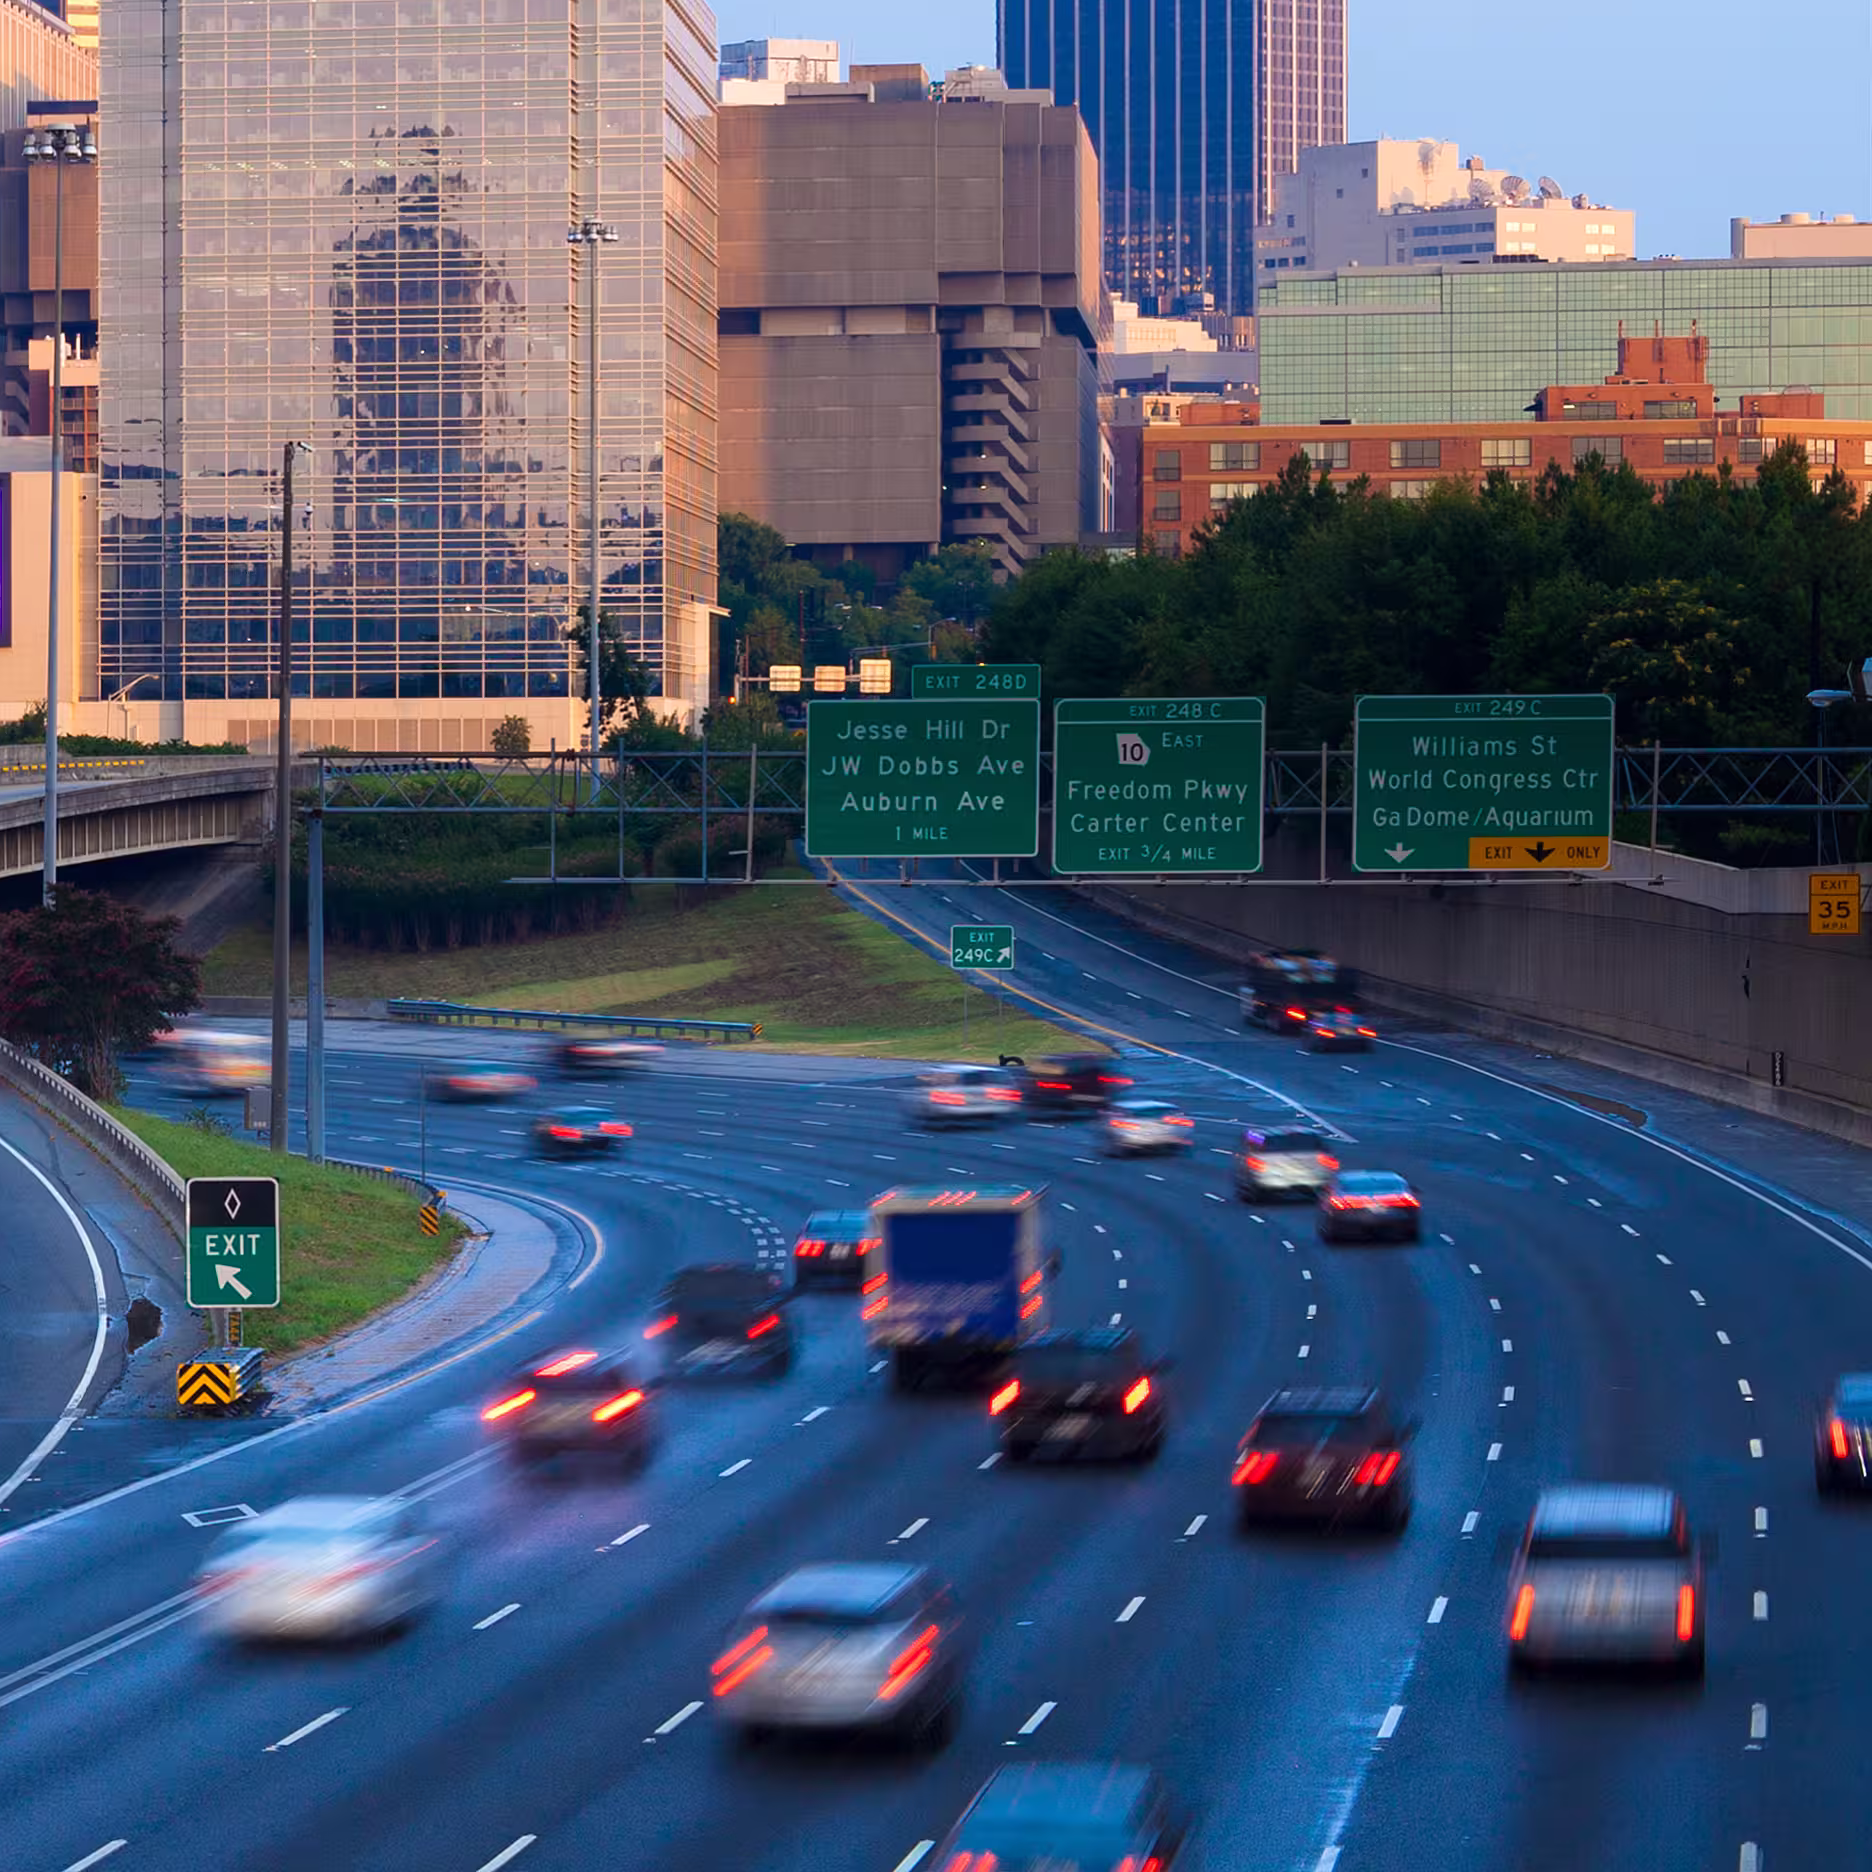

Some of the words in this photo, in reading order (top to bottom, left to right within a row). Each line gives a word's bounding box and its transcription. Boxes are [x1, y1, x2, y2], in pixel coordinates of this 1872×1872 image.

[926, 676, 960, 689] EXIT
[976, 674, 1026, 689] 248D
[1130, 706, 1156, 716] EXIT
[1166, 703, 1202, 718] 248
[1455, 702, 1481, 713] EXIT
[1490, 700, 1525, 715] 249
[837, 721, 908, 740] Jesse
[926, 720, 964, 739] Hill
[982, 720, 1010, 739] Dr
[1162, 732, 1204, 747] EAST
[1413, 737, 1517, 756] Williams
[1531, 735, 1557, 755] St
[1121, 743, 1143, 761] 10
[822, 756, 861, 775] JW
[879, 756, 959, 775] Dobbs
[977, 756, 1024, 775] Ave
[1369, 769, 1432, 789] World
[1443, 769, 1552, 796] Congress
[1563, 769, 1599, 789] Ctr
[1068, 780, 1171, 800] Freedom
[1185, 779, 1248, 804] Pkwy
[841, 792, 937, 811] Auburn
[957, 791, 1005, 810] Ave
[1071, 813, 1149, 832] Carter
[1163, 813, 1245, 832] Center
[896, 826, 900, 840] 1
[913, 828, 948, 839] MILE
[1098, 848, 1130, 860] EXIT
[1182, 847, 1216, 859] MILE
[1485, 847, 1513, 859] EXIT
[1567, 846, 1601, 859] ONLY
[1820, 880, 1848, 890] EXIT
[1819, 901, 1850, 918] 35
[970, 932, 994, 942] EXIT
[955, 949, 993, 962] 249C
[206, 1234, 260, 1256] EXIT
